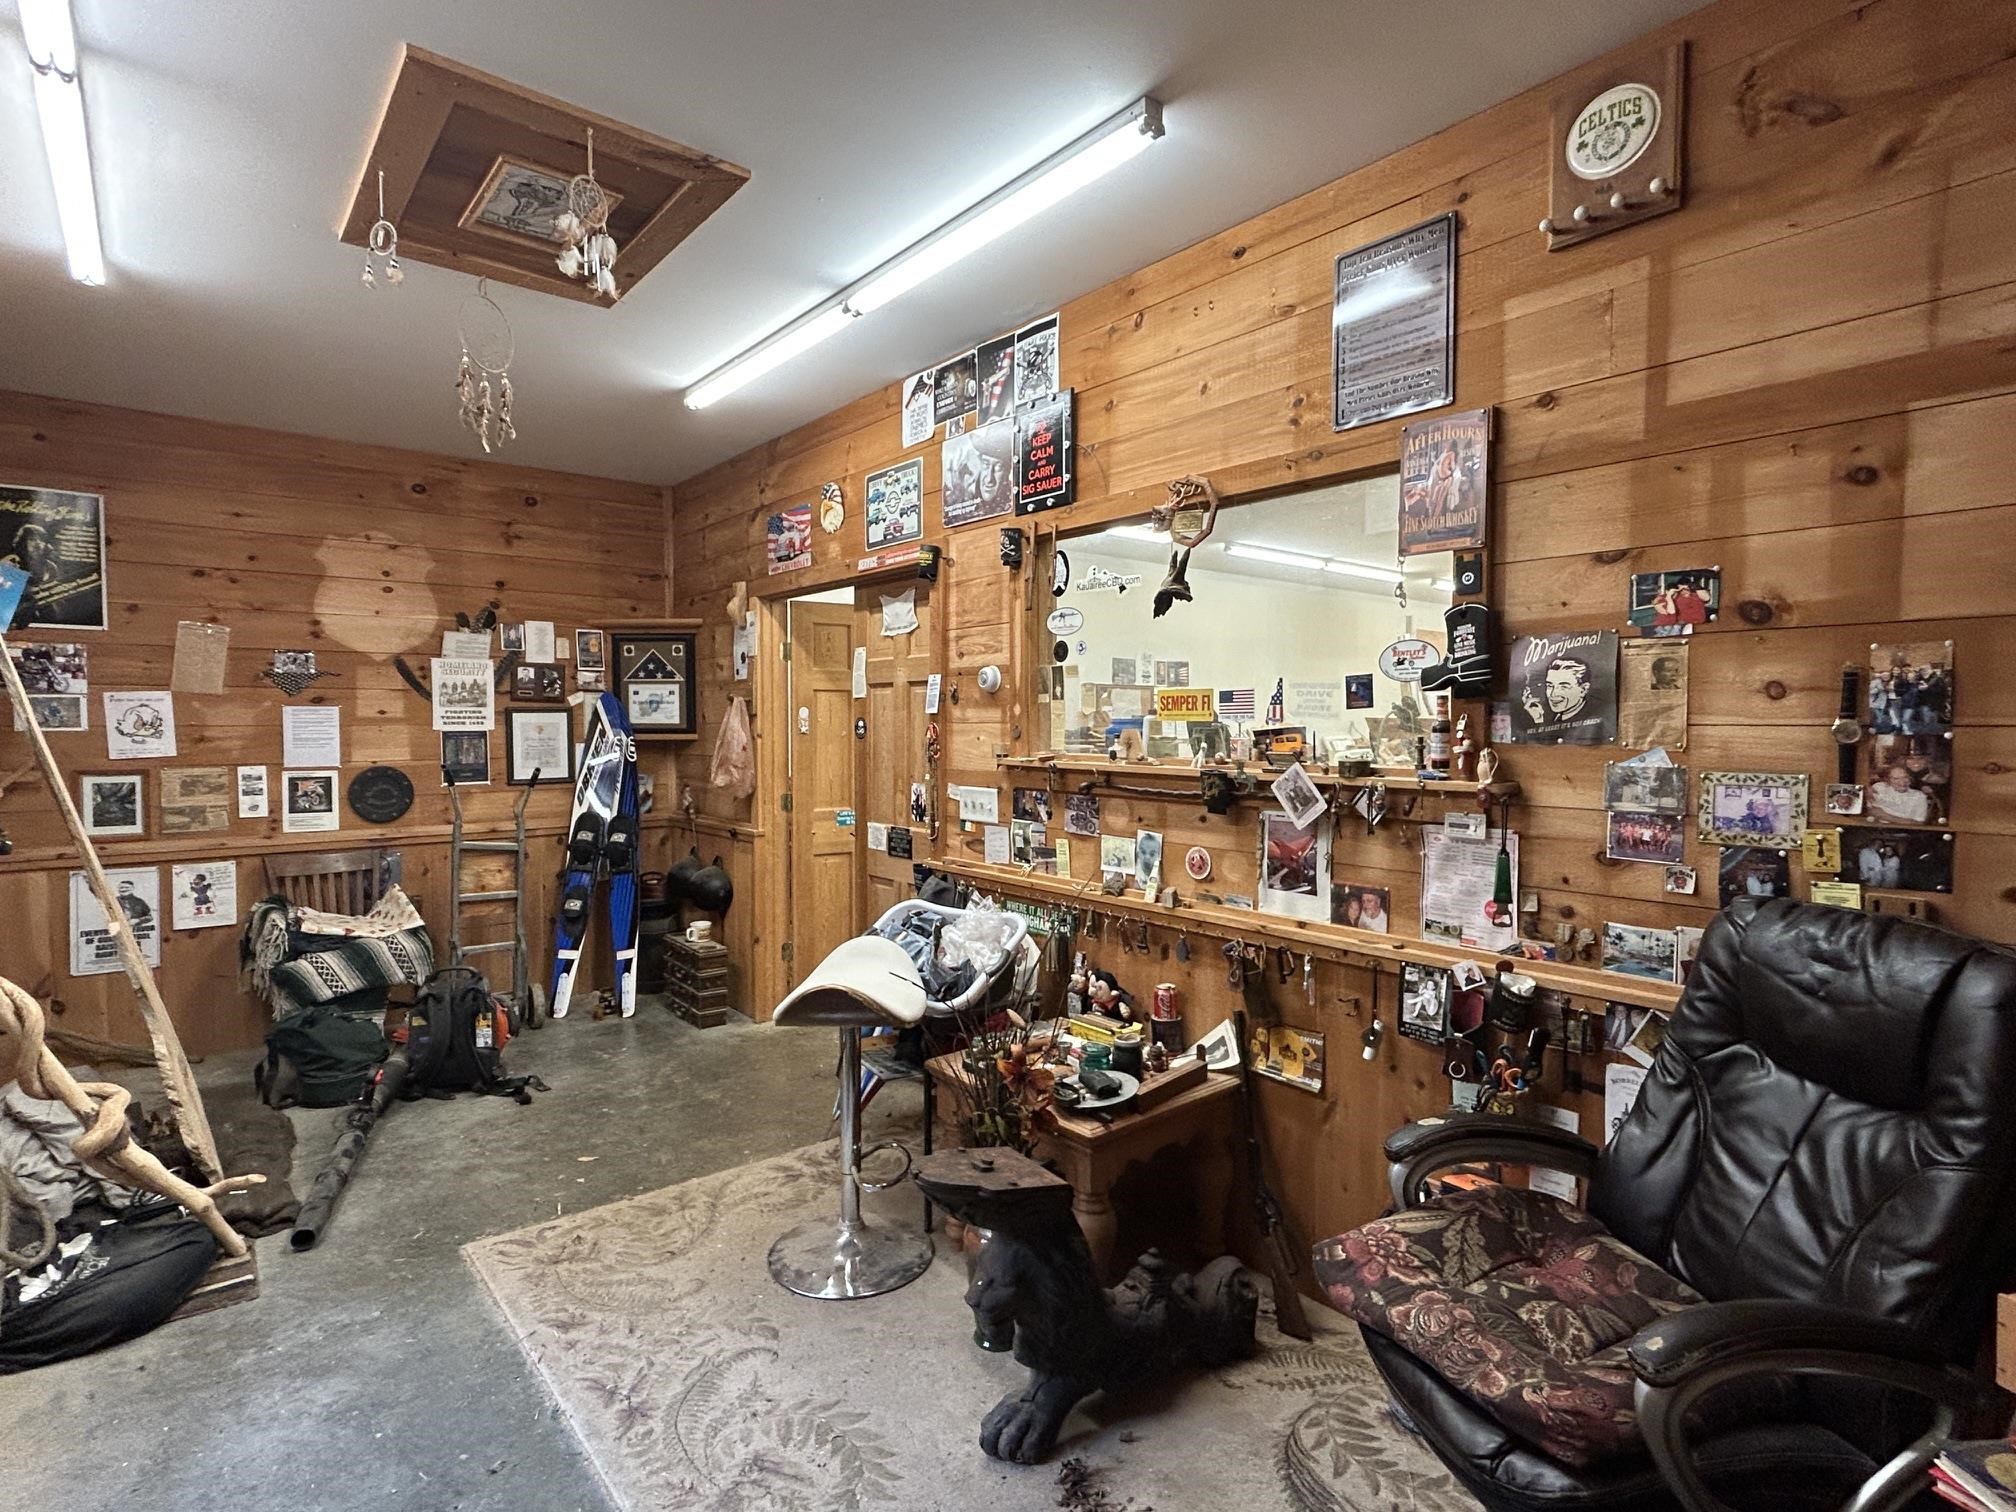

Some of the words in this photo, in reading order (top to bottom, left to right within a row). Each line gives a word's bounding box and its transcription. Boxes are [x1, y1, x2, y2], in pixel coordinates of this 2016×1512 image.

[1578, 97, 1642, 139] CELTICS
[1032, 433, 1052, 448] KEEP
[1408, 430, 1441, 454] AFTER
[1442, 423, 1484, 442] HOURS
[1030, 445, 1054, 461] CALM
[1028, 464, 1056, 481] CARRY
[1022, 483, 1035, 496] SIG
[1036, 476, 1063, 492] SAUER
[1446, 504, 1479, 528] WHISKEY
[1391, 648, 1427, 659] BENTLEY'S
[1523, 630, 1602, 667] Marijuana!
[439, 661, 488, 670] HOMELAND
[442, 669, 487, 677] SECURITY
[1160, 694, 1199, 713] SEMPER
[1202, 694, 1212, 712] FI
[1006, 900, 1028, 914] WHERE
[1029, 905, 1035, 915] IT
[1036, 907, 1050, 919] ALL
